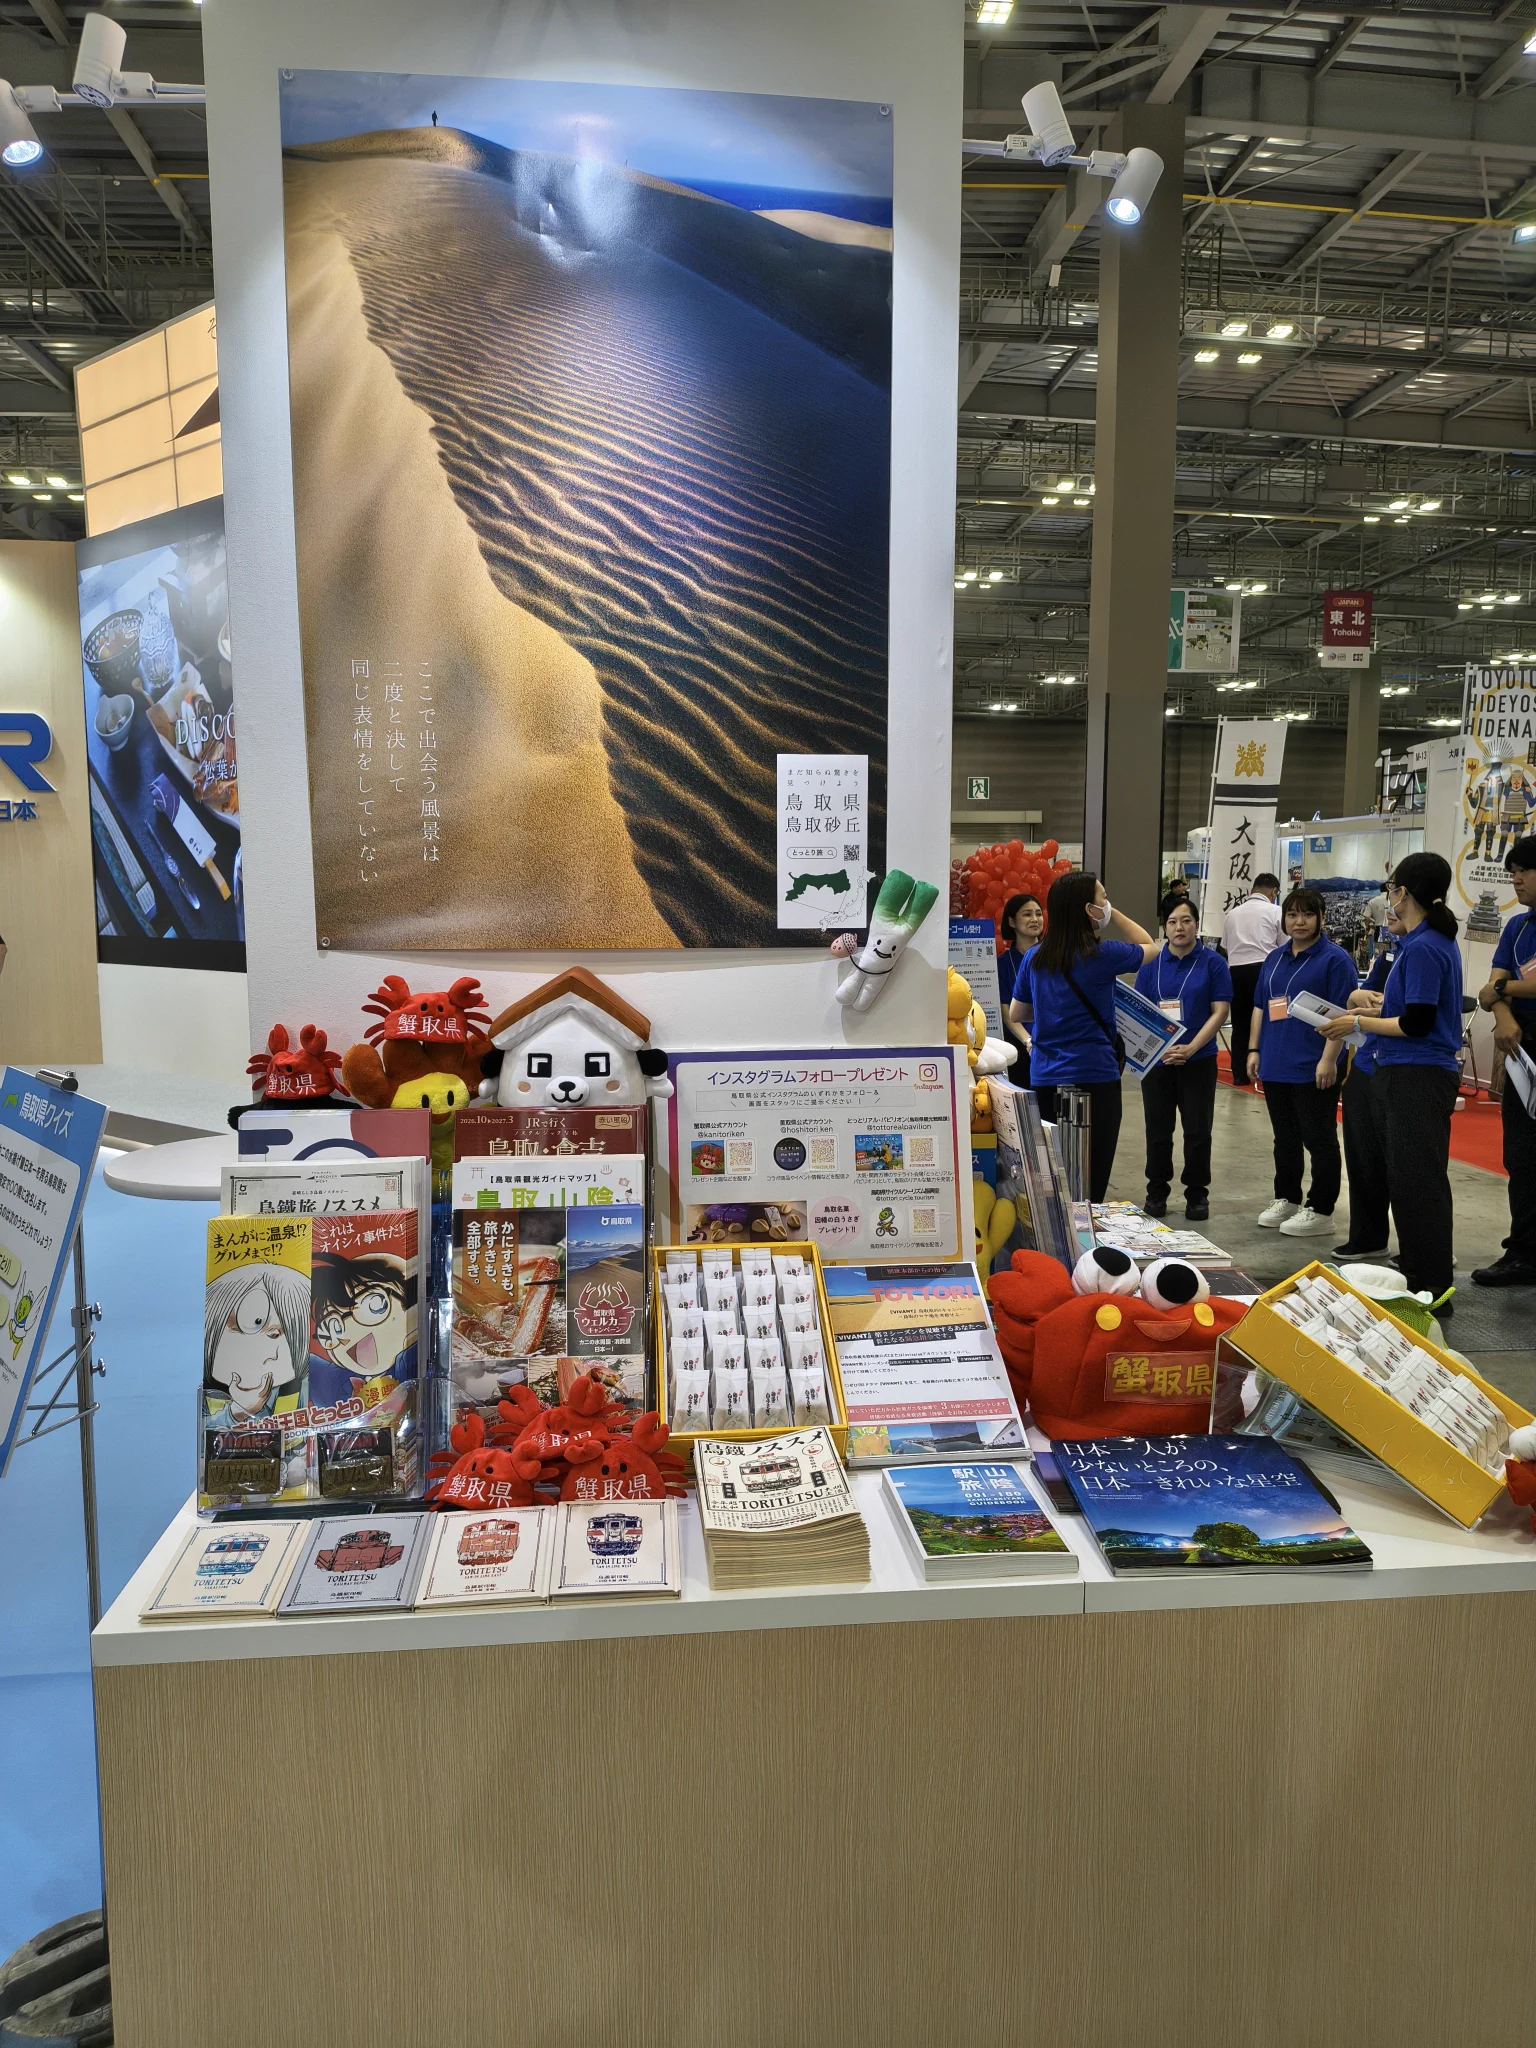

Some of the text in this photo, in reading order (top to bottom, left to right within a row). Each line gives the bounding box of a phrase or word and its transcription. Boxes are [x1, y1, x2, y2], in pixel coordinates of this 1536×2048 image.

[1330, 610, 1365, 625] 東北
[1332, 628, 1362, 637] Tohoku
[384, 661, 406, 792] 二度と決して
[351, 659, 378, 882] 同じ表情をしていない
[418, 662, 440, 861] ここで出会う風景は
[787, 769, 859, 777] まだ知らぬ驚きを
[787, 779, 859, 787] 見つけよう
[785, 793, 860, 811] 鳥取県
[785, 816, 860, 833] 鳥取砂丘
[397, 1014, 461, 1037] 蟹取県
[268, 1073, 317, 1095] 蟹取県
[707, 1067, 909, 1086] インスタグラムフォロープレゼント
[914, 1082, 944, 1092] Instagram
[19, 1091, 75, 1139] 鳥取県クイズ
[526, 1118, 566, 1128] JRで行く
[697, 1130, 745, 1139] @kanitoriken
[489, 1174, 598, 1184] 【鳥取県観光ガイドマップ】
[610, 1217, 632, 1226] 鳥取県
[814, 1215, 860, 1224] 因幡の白うさぎ
[212, 1223, 308, 1249] まんがに温泉!?
[319, 1222, 354, 1240] これは
[213, 1243, 283, 1264] グルメまで!?
[467, 1221, 482, 1285] 全部すき。
[484, 1221, 498, 1284] 旅すきも、
[501, 1221, 514, 1298] かにすきも、
[868, 1284, 975, 1302] TOTTORI
[581, 1317, 627, 1326] ウェルカニ
[1112, 1356, 1214, 1397] 蟹取県
[1070, 1459, 1229, 1473] 少ないところの、
[444, 1472, 512, 1507] 蟹取県
[574, 1473, 652, 1500] 蟹取県
[1081, 1472, 1302, 1491] 日本一きれいな星空
[739, 1488, 824, 1510] TORITETSU
[590, 1557, 638, 1565] TORITETSU
[327, 1573, 378, 1583] TORITETSU
[459, 1566, 508, 1576] TORITETSU
[193, 1577, 245, 1587] TORITETSU
